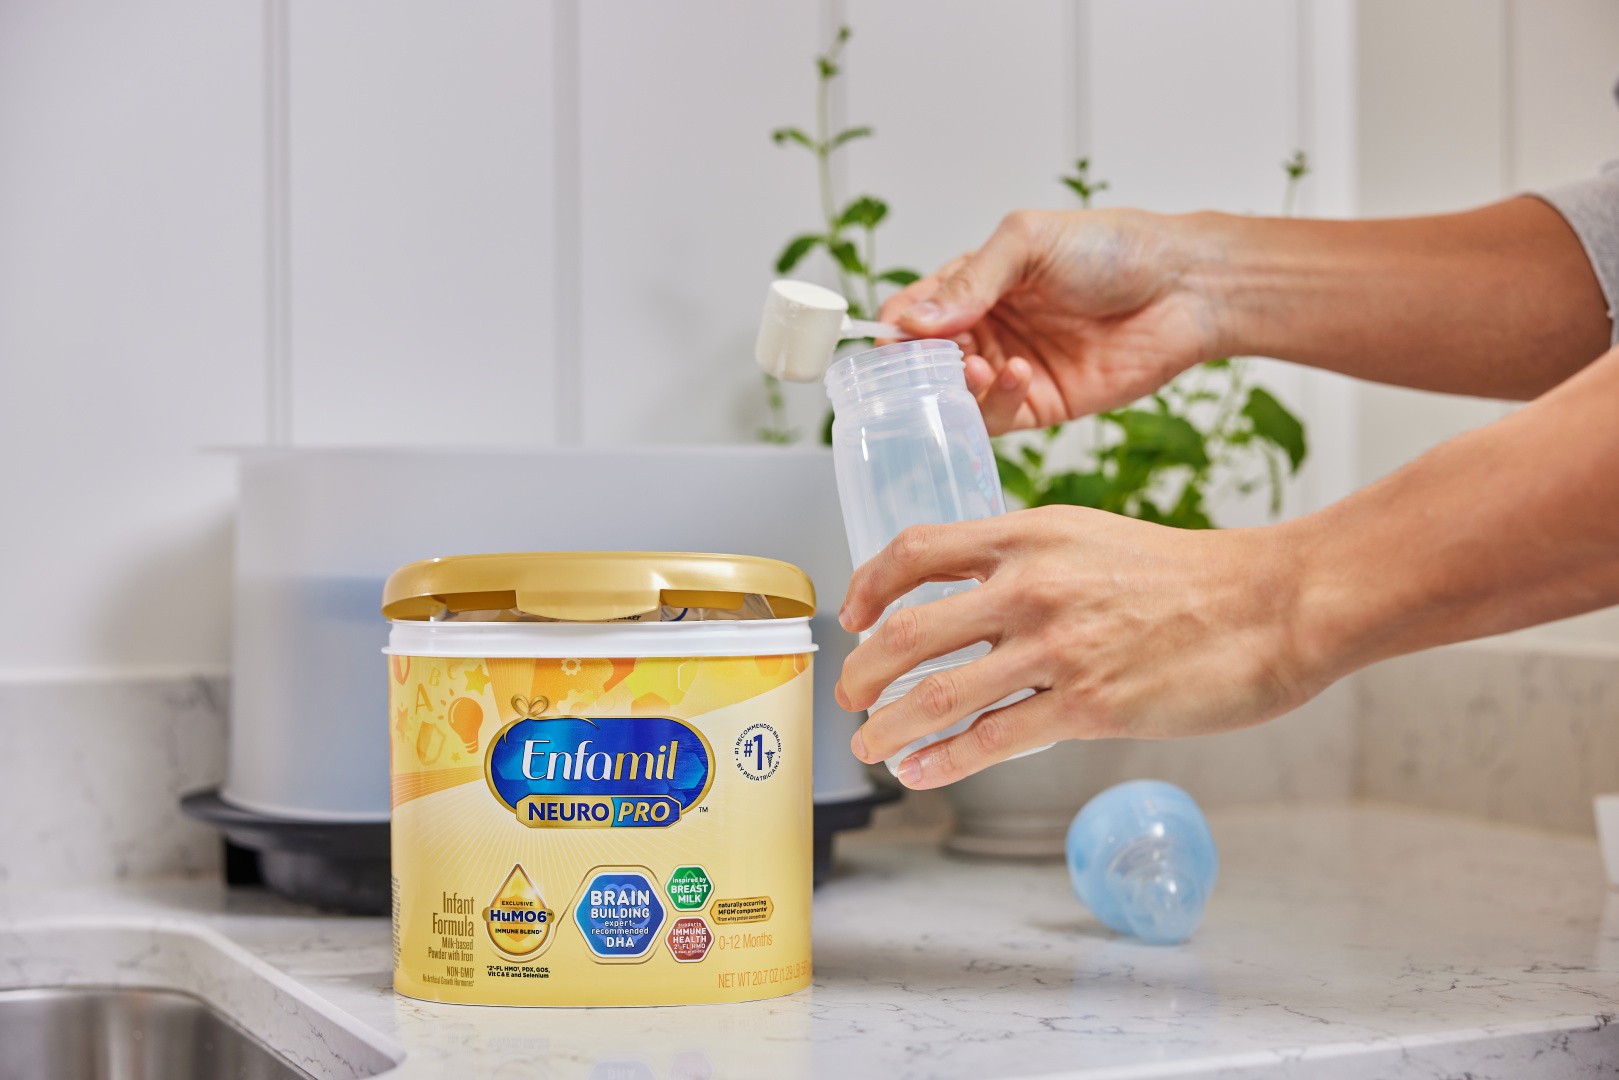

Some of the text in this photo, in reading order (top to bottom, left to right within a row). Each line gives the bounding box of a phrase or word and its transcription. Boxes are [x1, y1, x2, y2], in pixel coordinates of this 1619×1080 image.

[736, 723, 773, 746] RECOMMENDED
[773, 731, 781, 752] BRAND
[522, 740, 678, 780] Enfamil
[744, 734, 762, 770] #1
[737, 761, 779, 781] BY PEDIATRICIANS
[528, 802, 671, 822] NEURO PRO
[671, 884, 708, 894] BREAST
[443, 892, 474, 914] Infant
[590, 890, 650, 906] BRAIN
[678, 894, 701, 903] MILK
[590, 907, 650, 919] BUILDING
[433, 912, 474, 937] Formula
[591, 927, 649, 935] recommended
[604, 920, 636, 928] expert-
[673, 927, 707, 936] IMMUNE
[442, 937, 473, 950] Milk-based
[606, 936, 635, 948] DHA
[718, 932, 773, 950] 0-12 Months
[428, 947, 474, 962] Powder with Iron
[718, 973, 735, 988] NET
[738, 971, 751, 987] WT
[752, 970, 768, 986] 20.7
[770, 967, 779, 984] OZ
